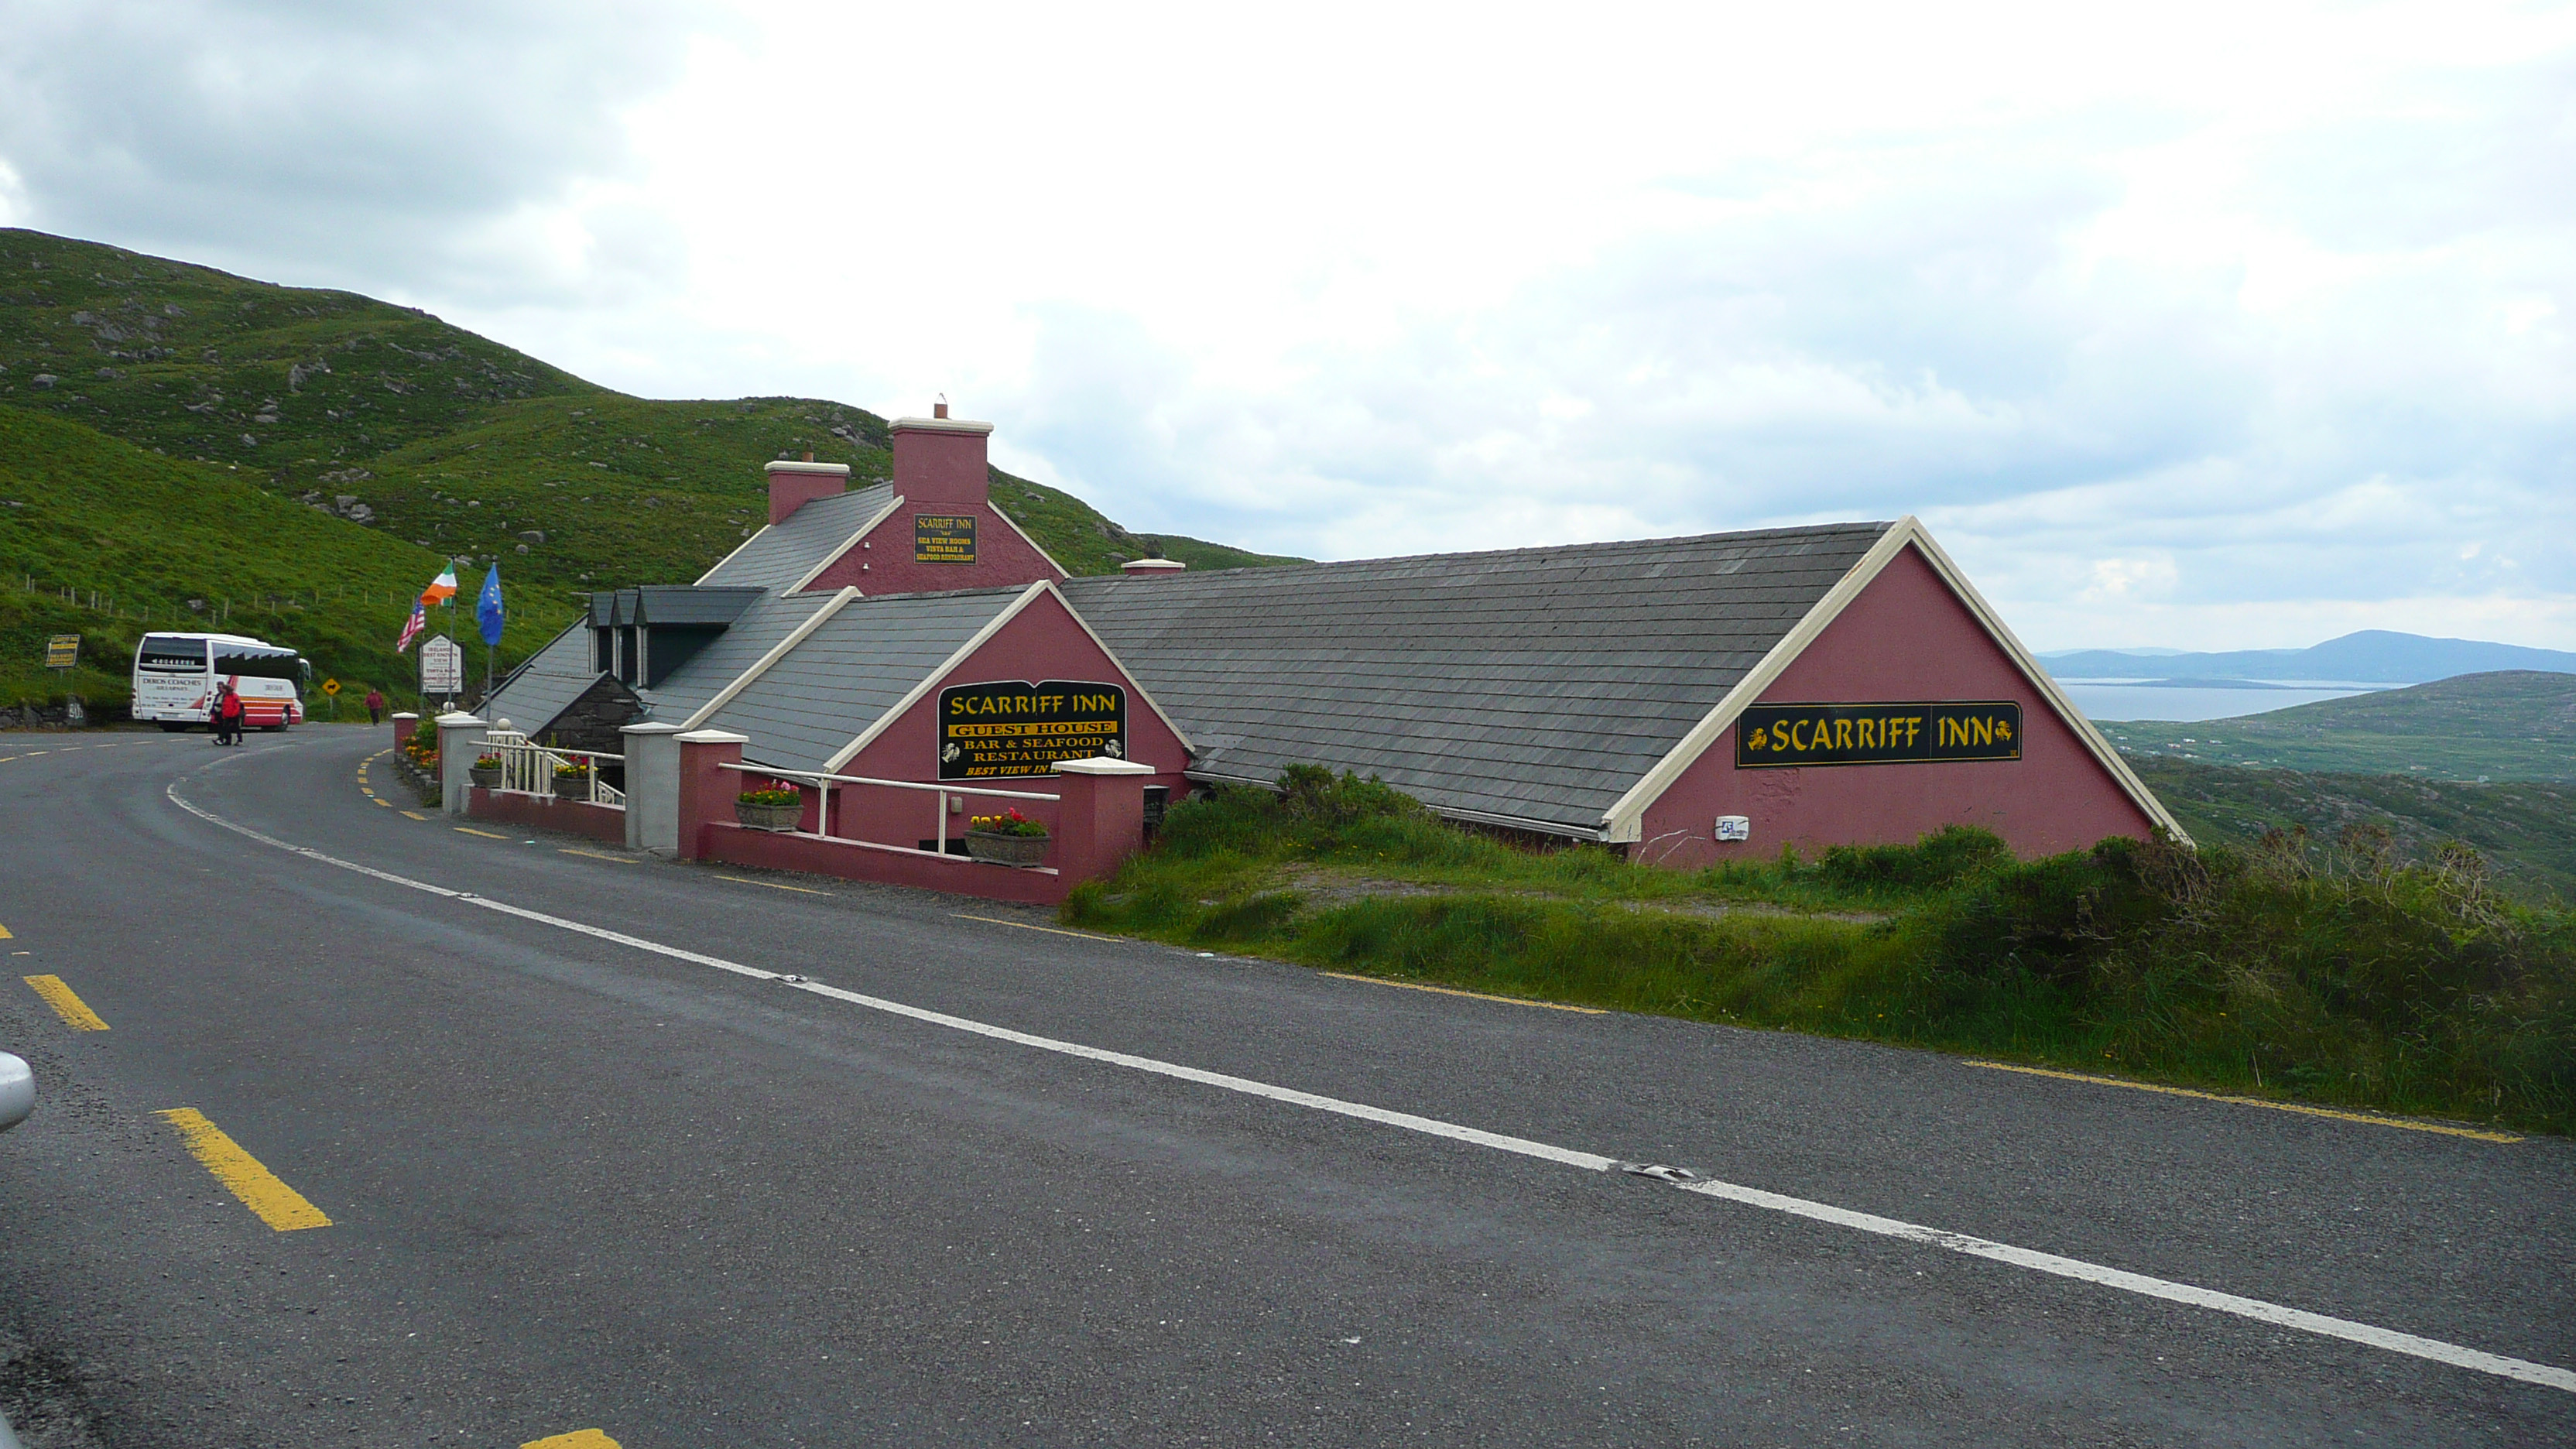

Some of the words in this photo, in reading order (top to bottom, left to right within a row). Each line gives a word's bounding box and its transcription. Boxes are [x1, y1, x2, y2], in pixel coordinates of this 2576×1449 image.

[918, 518, 954, 529] SCARRIFF
[956, 519, 971, 529] INN
[951, 695, 1064, 715] SCARRIFF
[1073, 694, 1115, 713] INN
[955, 724, 1031, 736] GUEST
[1036, 722, 1112, 734] HOUSE
[1771, 717, 1922, 752] SCARRIFF
[1937, 715, 1993, 748] INN
[964, 740, 1001, 750] BAR
[1005, 739, 1018, 748] &
[1023, 737, 1104, 748] SEAFOOD
[973, 749, 1096, 762] RESTAURANT
[965, 766, 998, 776] BEST
[999, 766, 1033, 775] VIEW
[1033, 765, 1049, 774] IN
